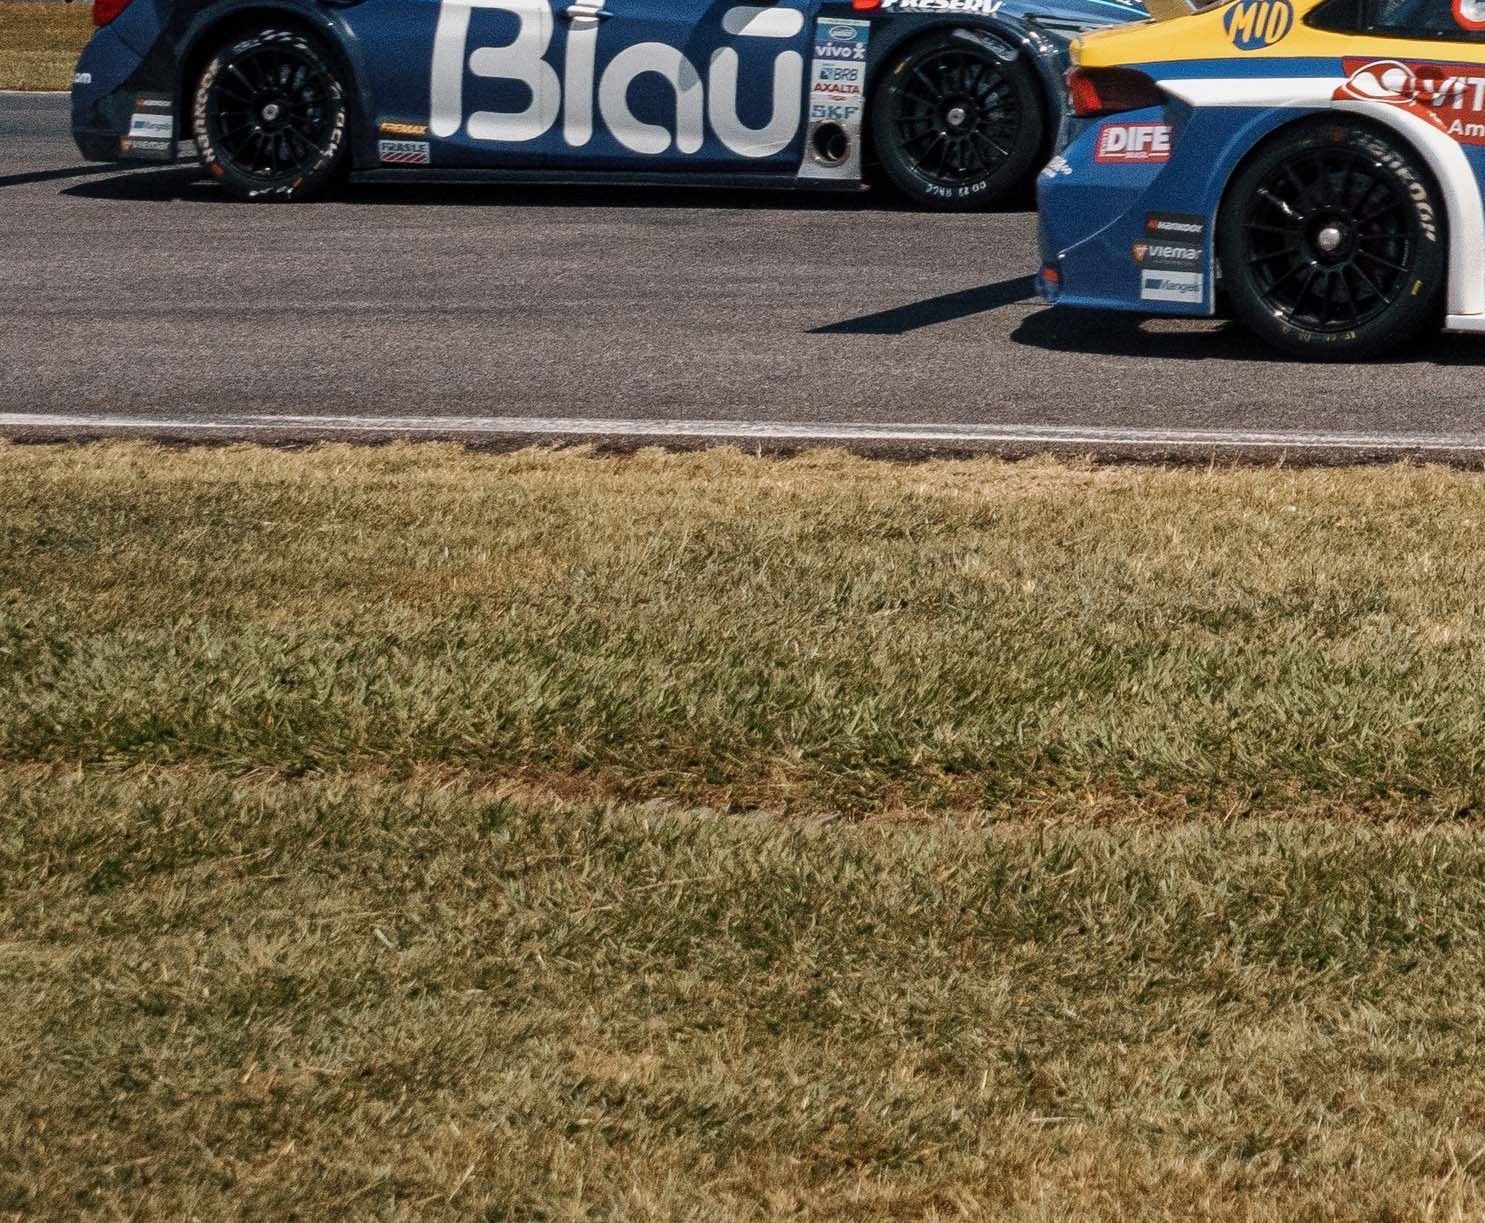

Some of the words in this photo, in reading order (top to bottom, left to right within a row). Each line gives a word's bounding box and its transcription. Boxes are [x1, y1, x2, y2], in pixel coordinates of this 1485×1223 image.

[815, 42, 851, 58] vivo
[834, 68, 858, 82] BRB
[813, 83, 860, 95] AXALTA
[811, 105, 860, 120] SKF
[1103, 126, 1172, 152] DIFE
